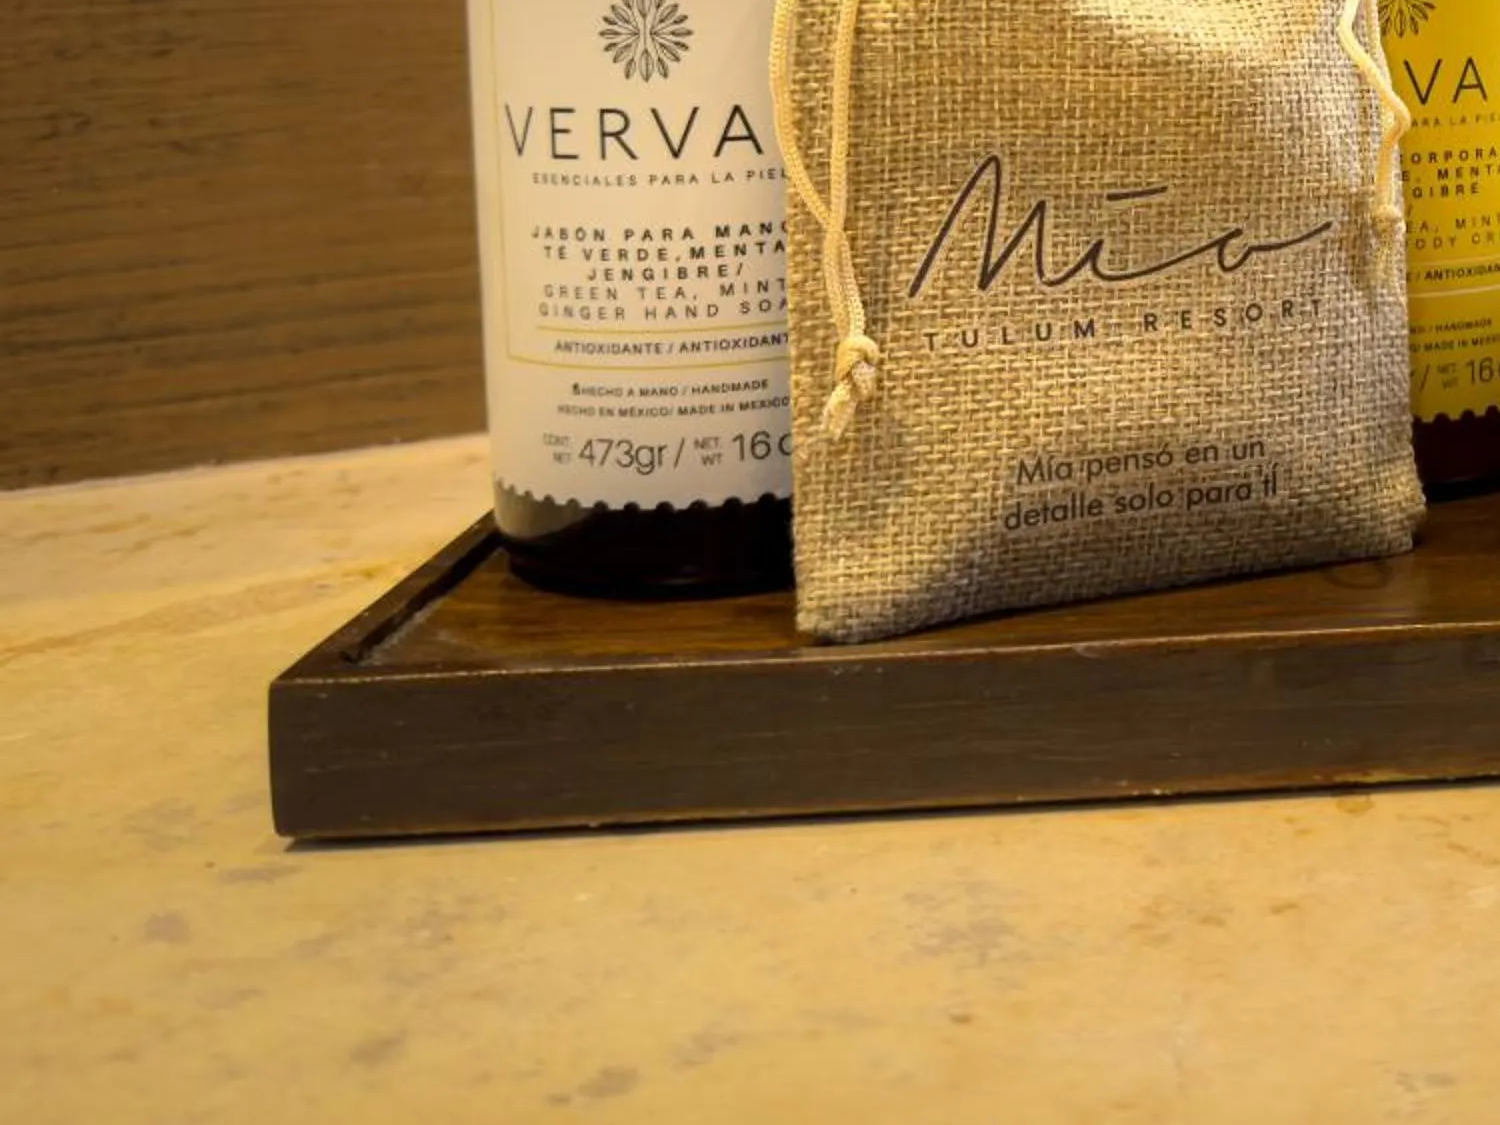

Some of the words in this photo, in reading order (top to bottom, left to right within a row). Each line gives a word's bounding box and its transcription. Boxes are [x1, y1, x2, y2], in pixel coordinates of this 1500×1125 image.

[1410, 117, 1441, 128] ARA
[1449, 115, 1468, 126] LA
[504, 104, 764, 161] VERVA
[532, 172, 638, 188] ESENCIALES
[649, 174, 700, 187] PARA
[711, 171, 735, 185] LA
[1411, 182, 1481, 199] GIBRE
[623, 227, 695, 242] PARA
[1405, 220, 1440, 235] EA,
[1405, 235, 1457, 251] ODY
[543, 283, 618, 301] GREEN
[538, 301, 625, 321] GINGER
[645, 303, 719, 321] HAND
[739, 298, 788, 314] SOA
[922, 317, 1096, 354] TULUM
[1143, 297, 1324, 333] RESORT
[554, 340, 662, 356] ANTIOXIDANTE
[639, 386, 679, 397] MANO
[691, 379, 769, 395] HANDMADE
[677, 404, 715, 417] MADE
[721, 402, 735, 413] IN
[579, 438, 668, 476] 473gr
[1086, 443, 1174, 483] pensó
[1185, 445, 1219, 465] en
[1232, 440, 1266, 461] un
[1003, 491, 1105, 531] detalle
[1115, 481, 1174, 515] solo
[1186, 483, 1253, 511] para
